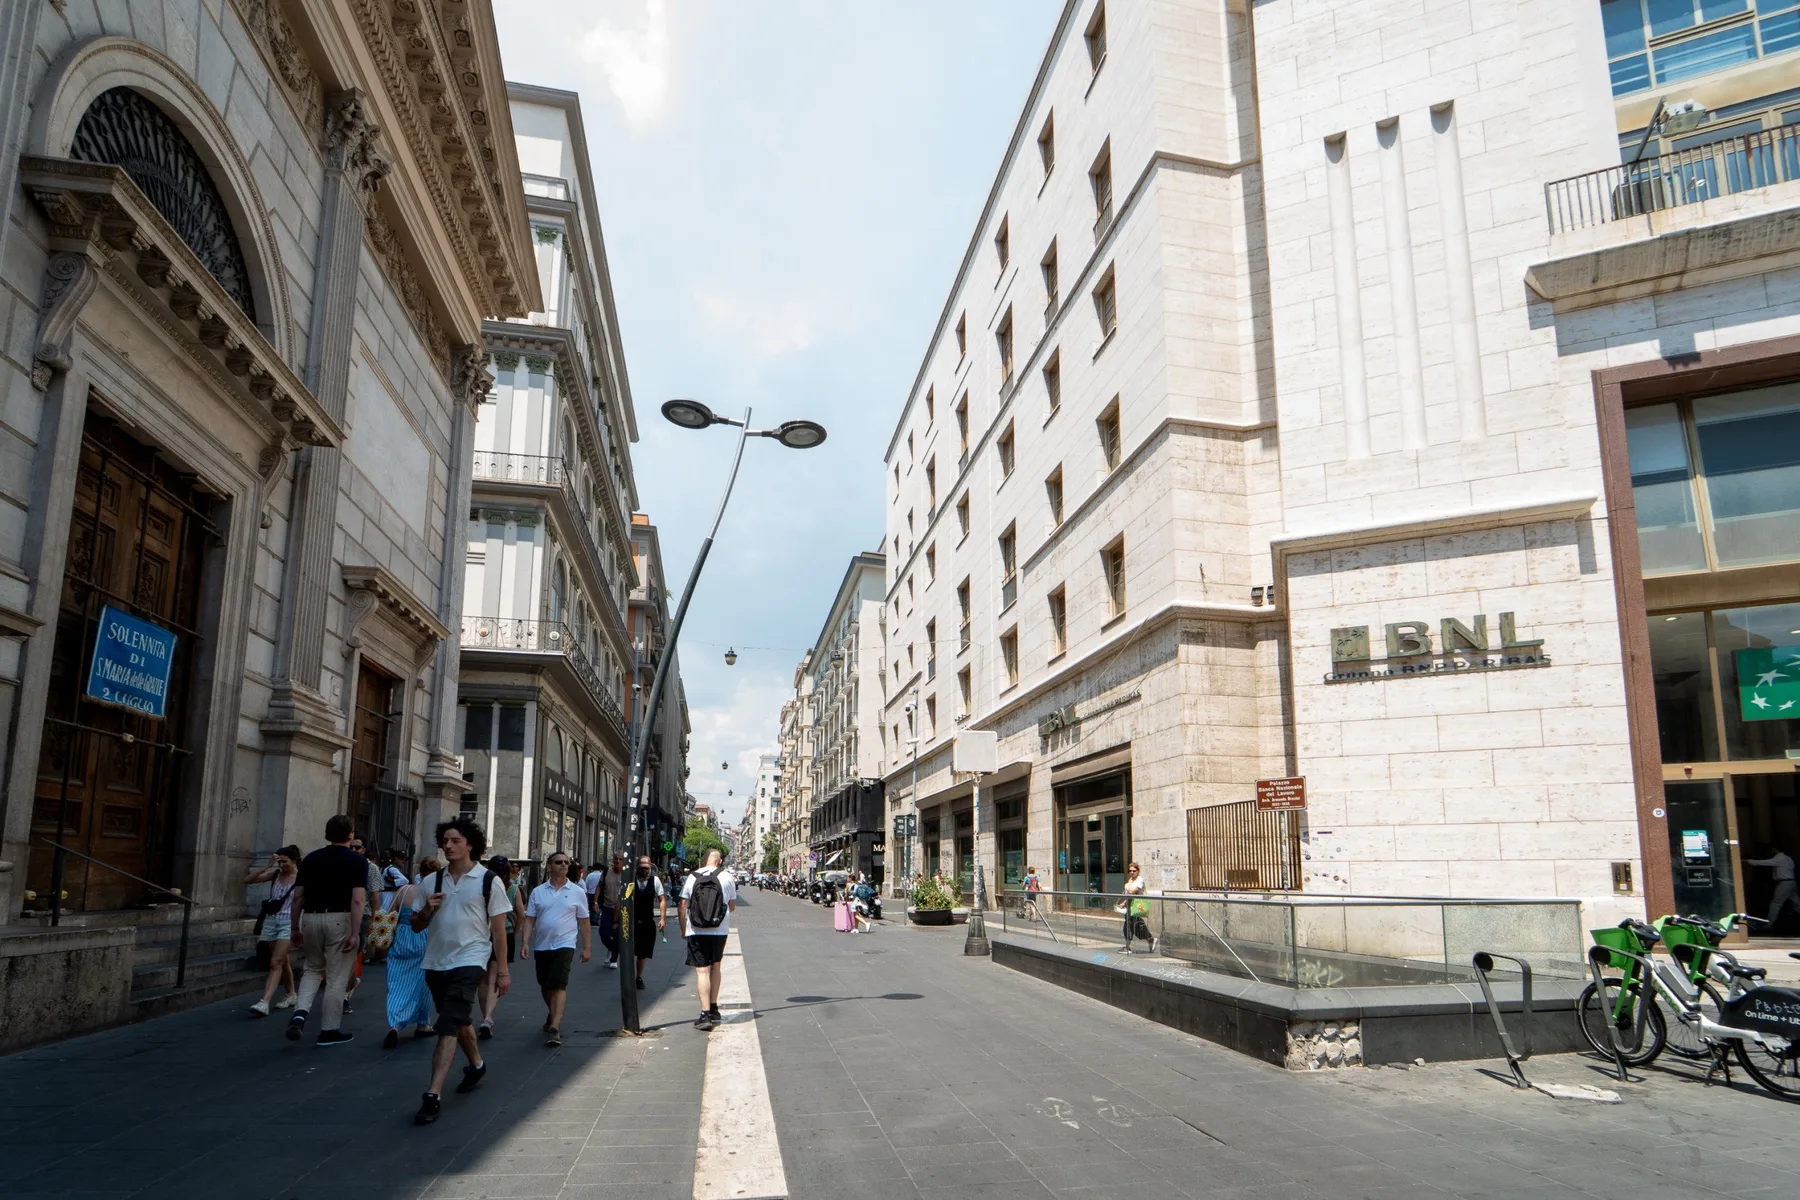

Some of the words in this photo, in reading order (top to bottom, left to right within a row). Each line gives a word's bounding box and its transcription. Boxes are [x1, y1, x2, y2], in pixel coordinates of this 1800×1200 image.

[1385, 612, 1545, 658] BNL
[129, 653, 146, 667] DI
[1402, 662, 1447, 674] BNP
[103, 687, 111, 700] 2
[114, 691, 154, 714] LUGLIO
[1745, 1010, 1757, 1018] On
[1758, 1012, 1779, 1022] Lime
